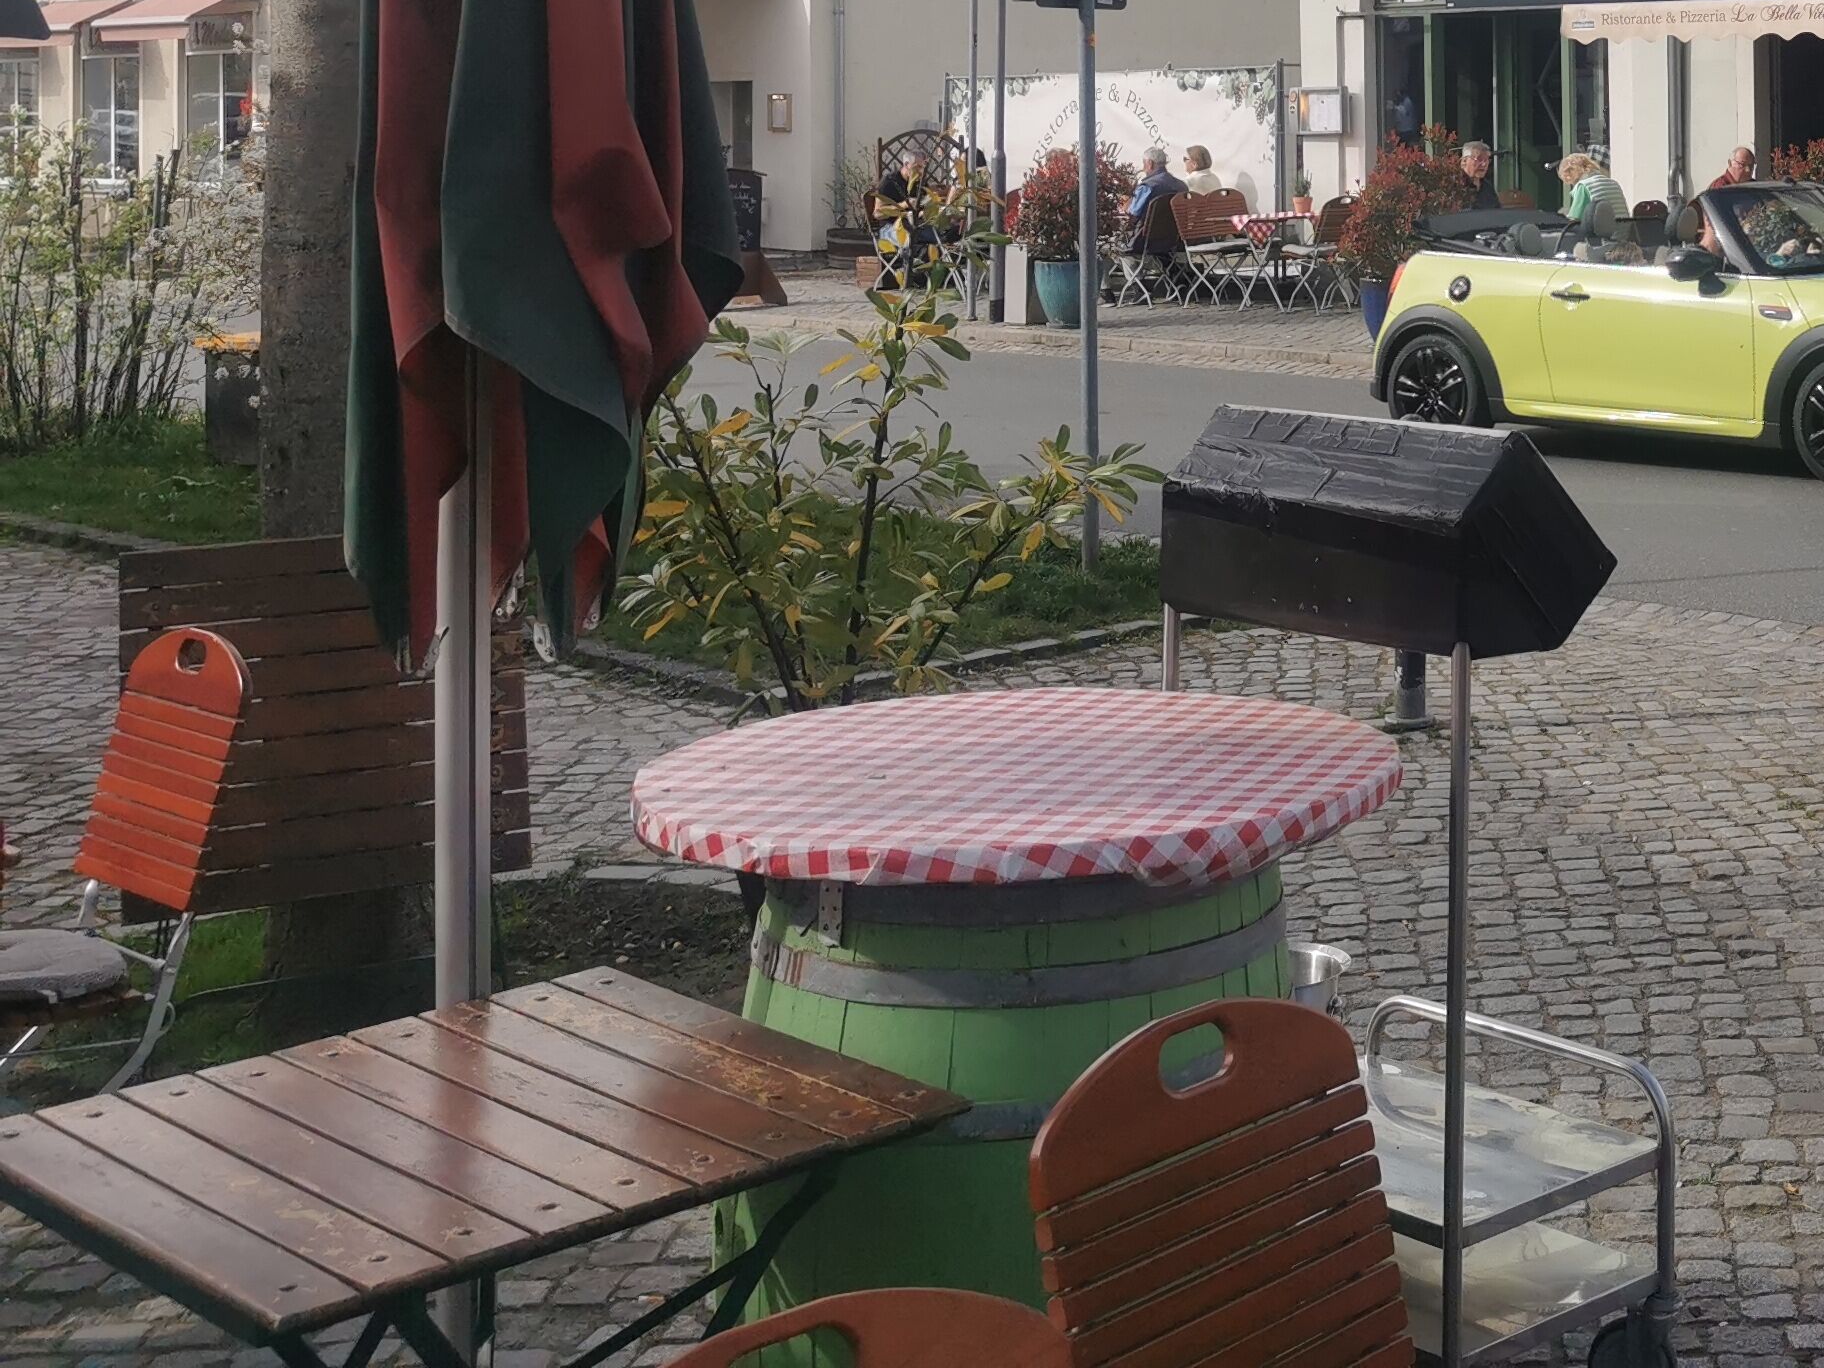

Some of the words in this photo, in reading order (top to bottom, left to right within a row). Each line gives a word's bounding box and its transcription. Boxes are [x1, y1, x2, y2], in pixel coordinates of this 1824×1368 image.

[1601, 13, 1662, 26] Ristorante
[1666, 12, 1677, 24] &
[1680, 9, 1726, 23] Pizzeria
[1730, 2, 1758, 23] La
[1760, 4, 1803, 22] Bella
[1032, 86, 1103, 168] Ristorae
[1108, 82, 1120, 103] &
[1124, 88, 1171, 150] Pizzeri
